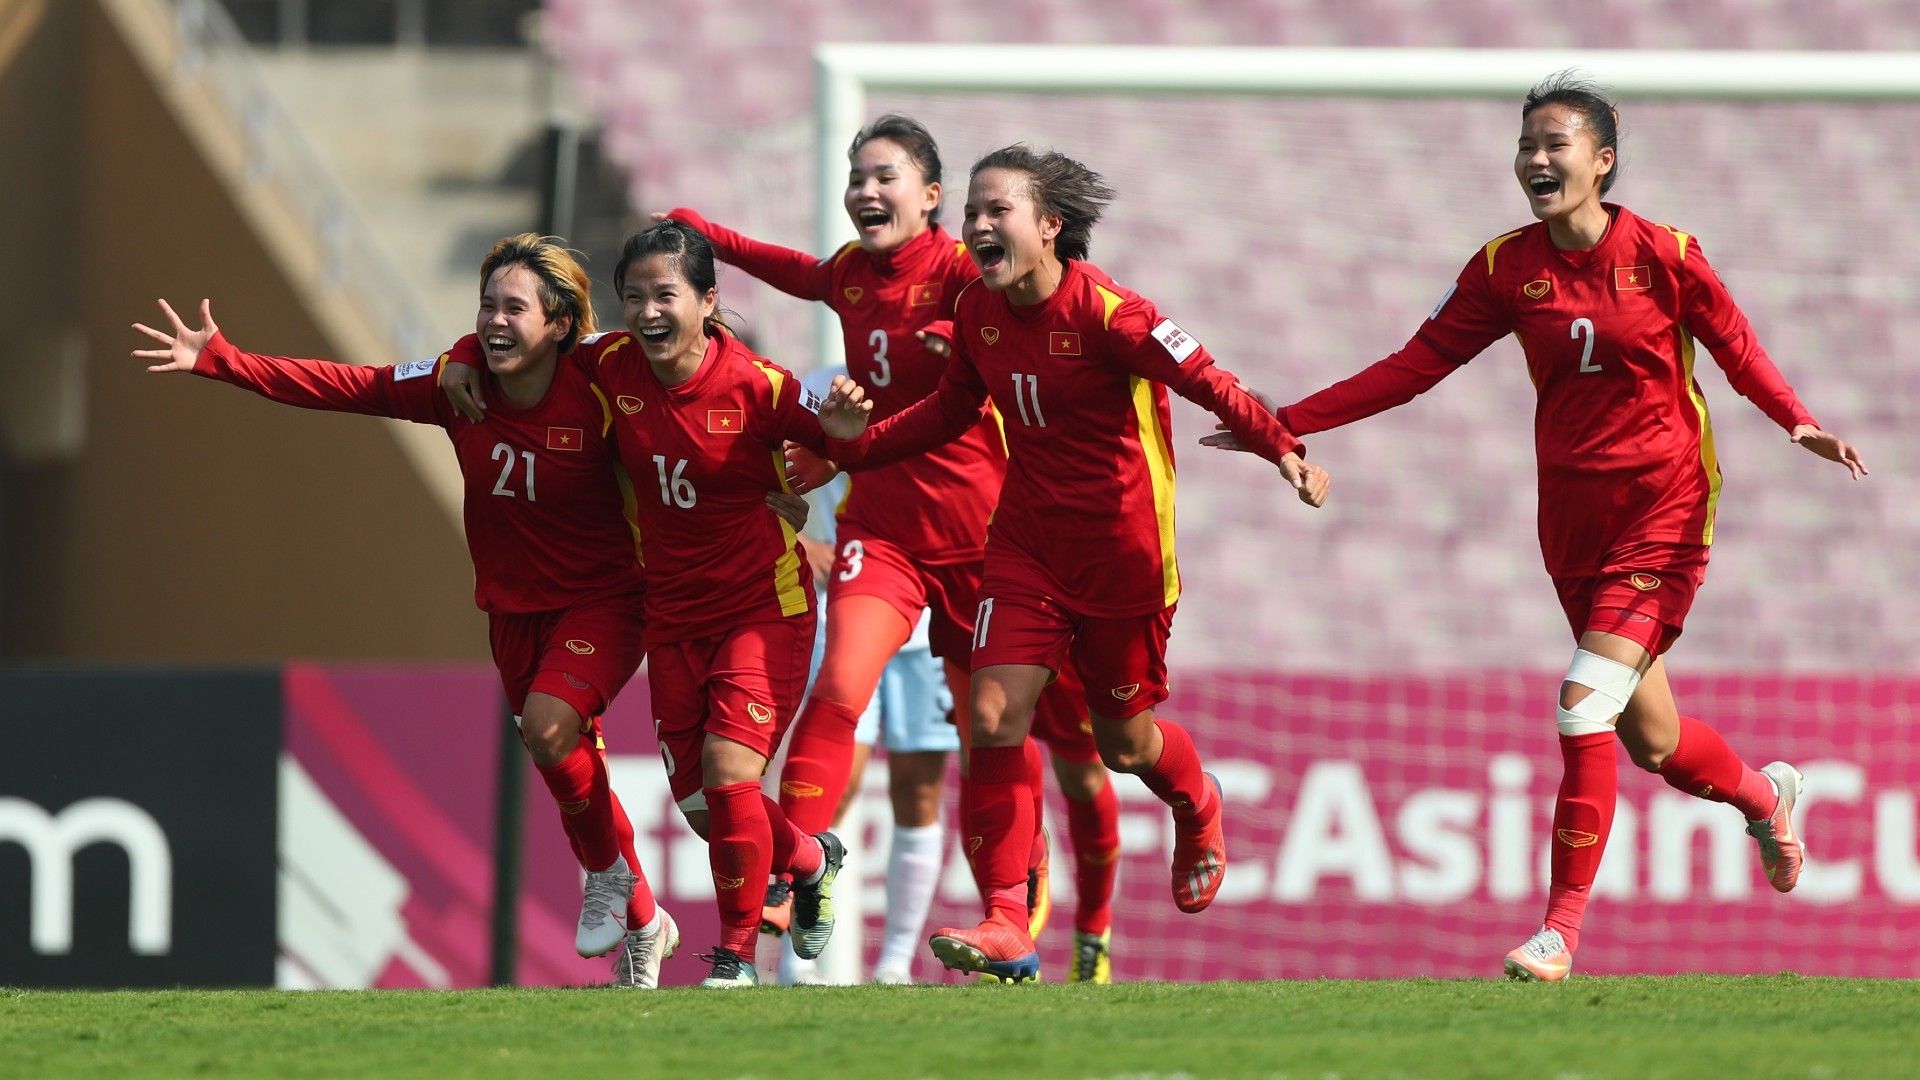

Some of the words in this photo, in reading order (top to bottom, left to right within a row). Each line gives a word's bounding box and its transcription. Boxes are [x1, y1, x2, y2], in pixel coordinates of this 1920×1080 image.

[868, 329, 892, 388] 3
[1570, 317, 1602, 373] 2
[1011, 372, 1047, 428] 11
[491, 442, 536, 502] 21
[652, 454, 697, 509] 16
[838, 539, 865, 582] 3
[972, 597, 995, 652] 11
